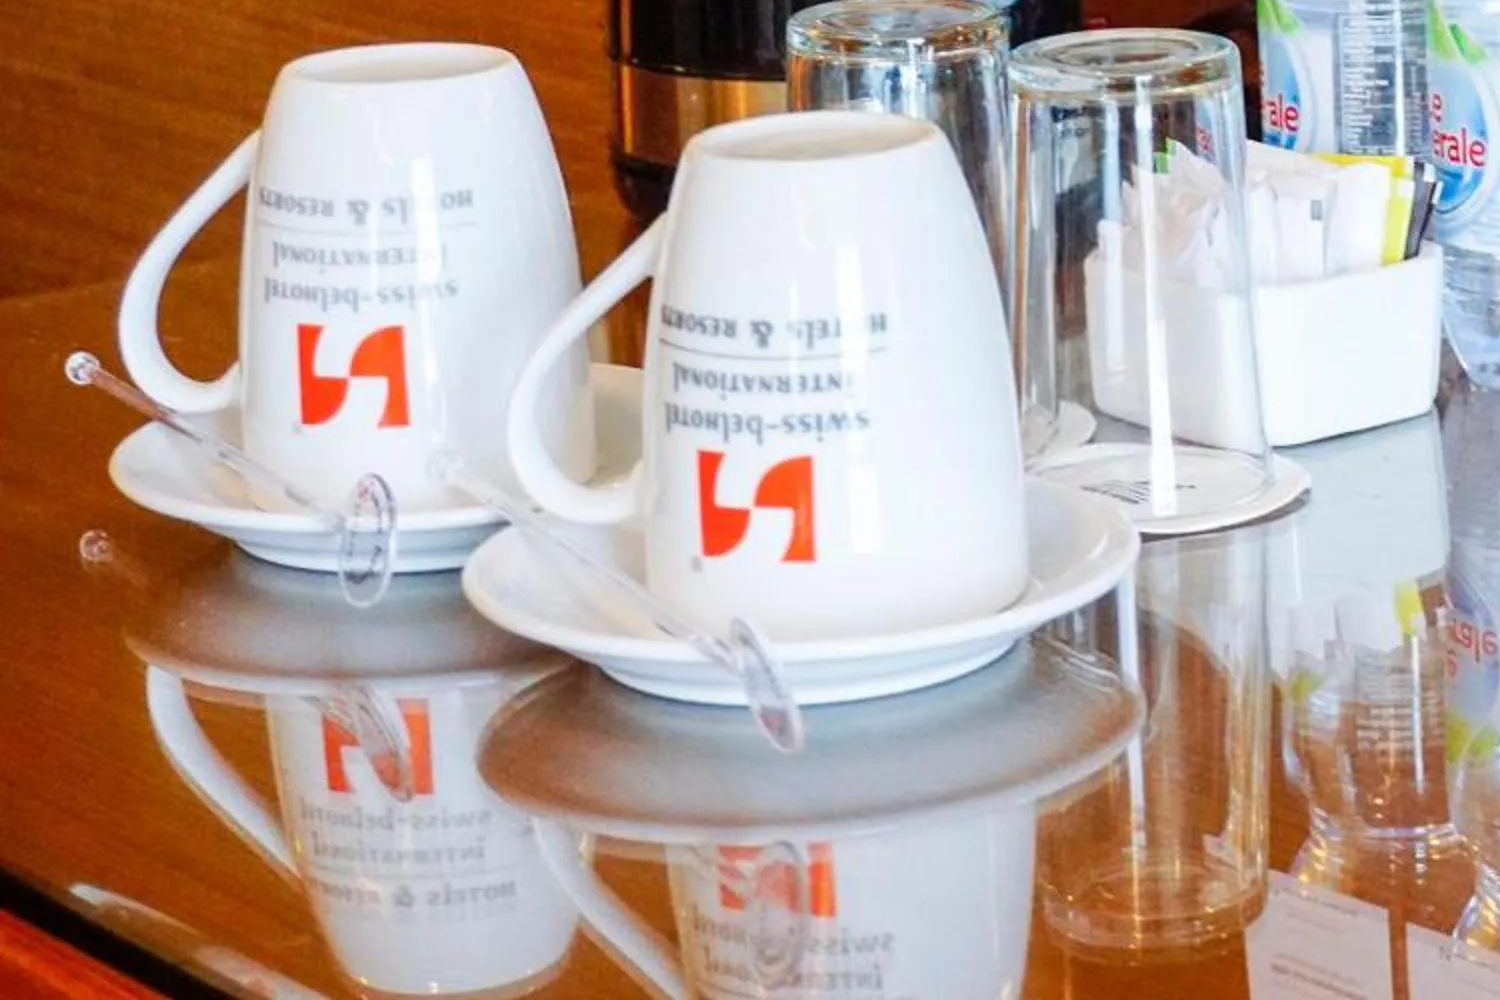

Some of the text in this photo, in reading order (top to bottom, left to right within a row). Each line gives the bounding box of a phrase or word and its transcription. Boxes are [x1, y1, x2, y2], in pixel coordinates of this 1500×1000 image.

[258, 186, 334, 217] RESORTS
[346, 200, 370, 225] &
[661, 304, 737, 339] RESORTS
[749, 320, 773, 349] &
